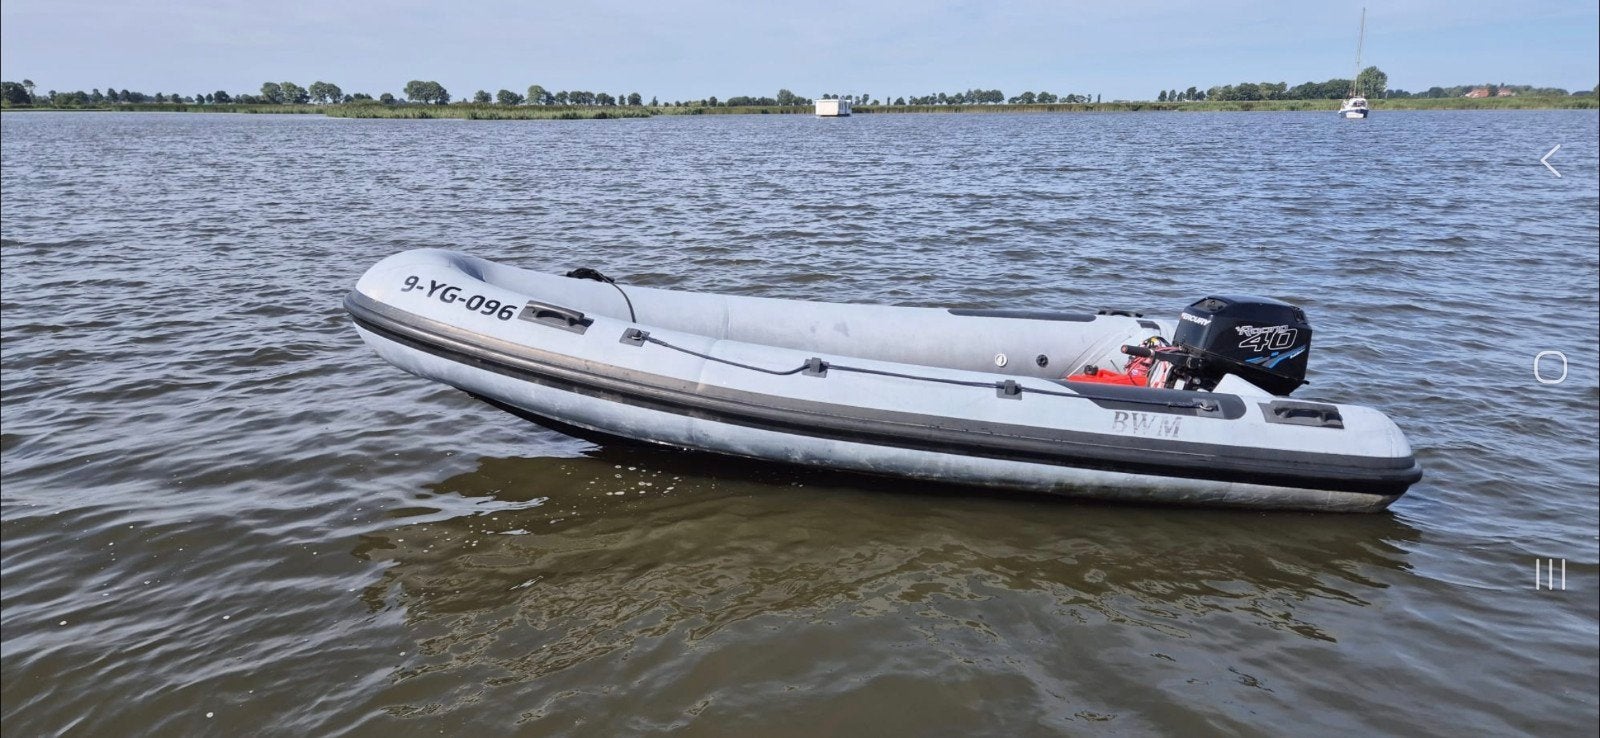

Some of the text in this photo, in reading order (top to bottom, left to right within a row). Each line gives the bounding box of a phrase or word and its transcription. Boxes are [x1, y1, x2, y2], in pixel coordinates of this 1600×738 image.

[401, 275, 518, 321] 9-YG-096
[1239, 328, 1298, 352] 40
[1112, 411, 1182, 438] BWM
